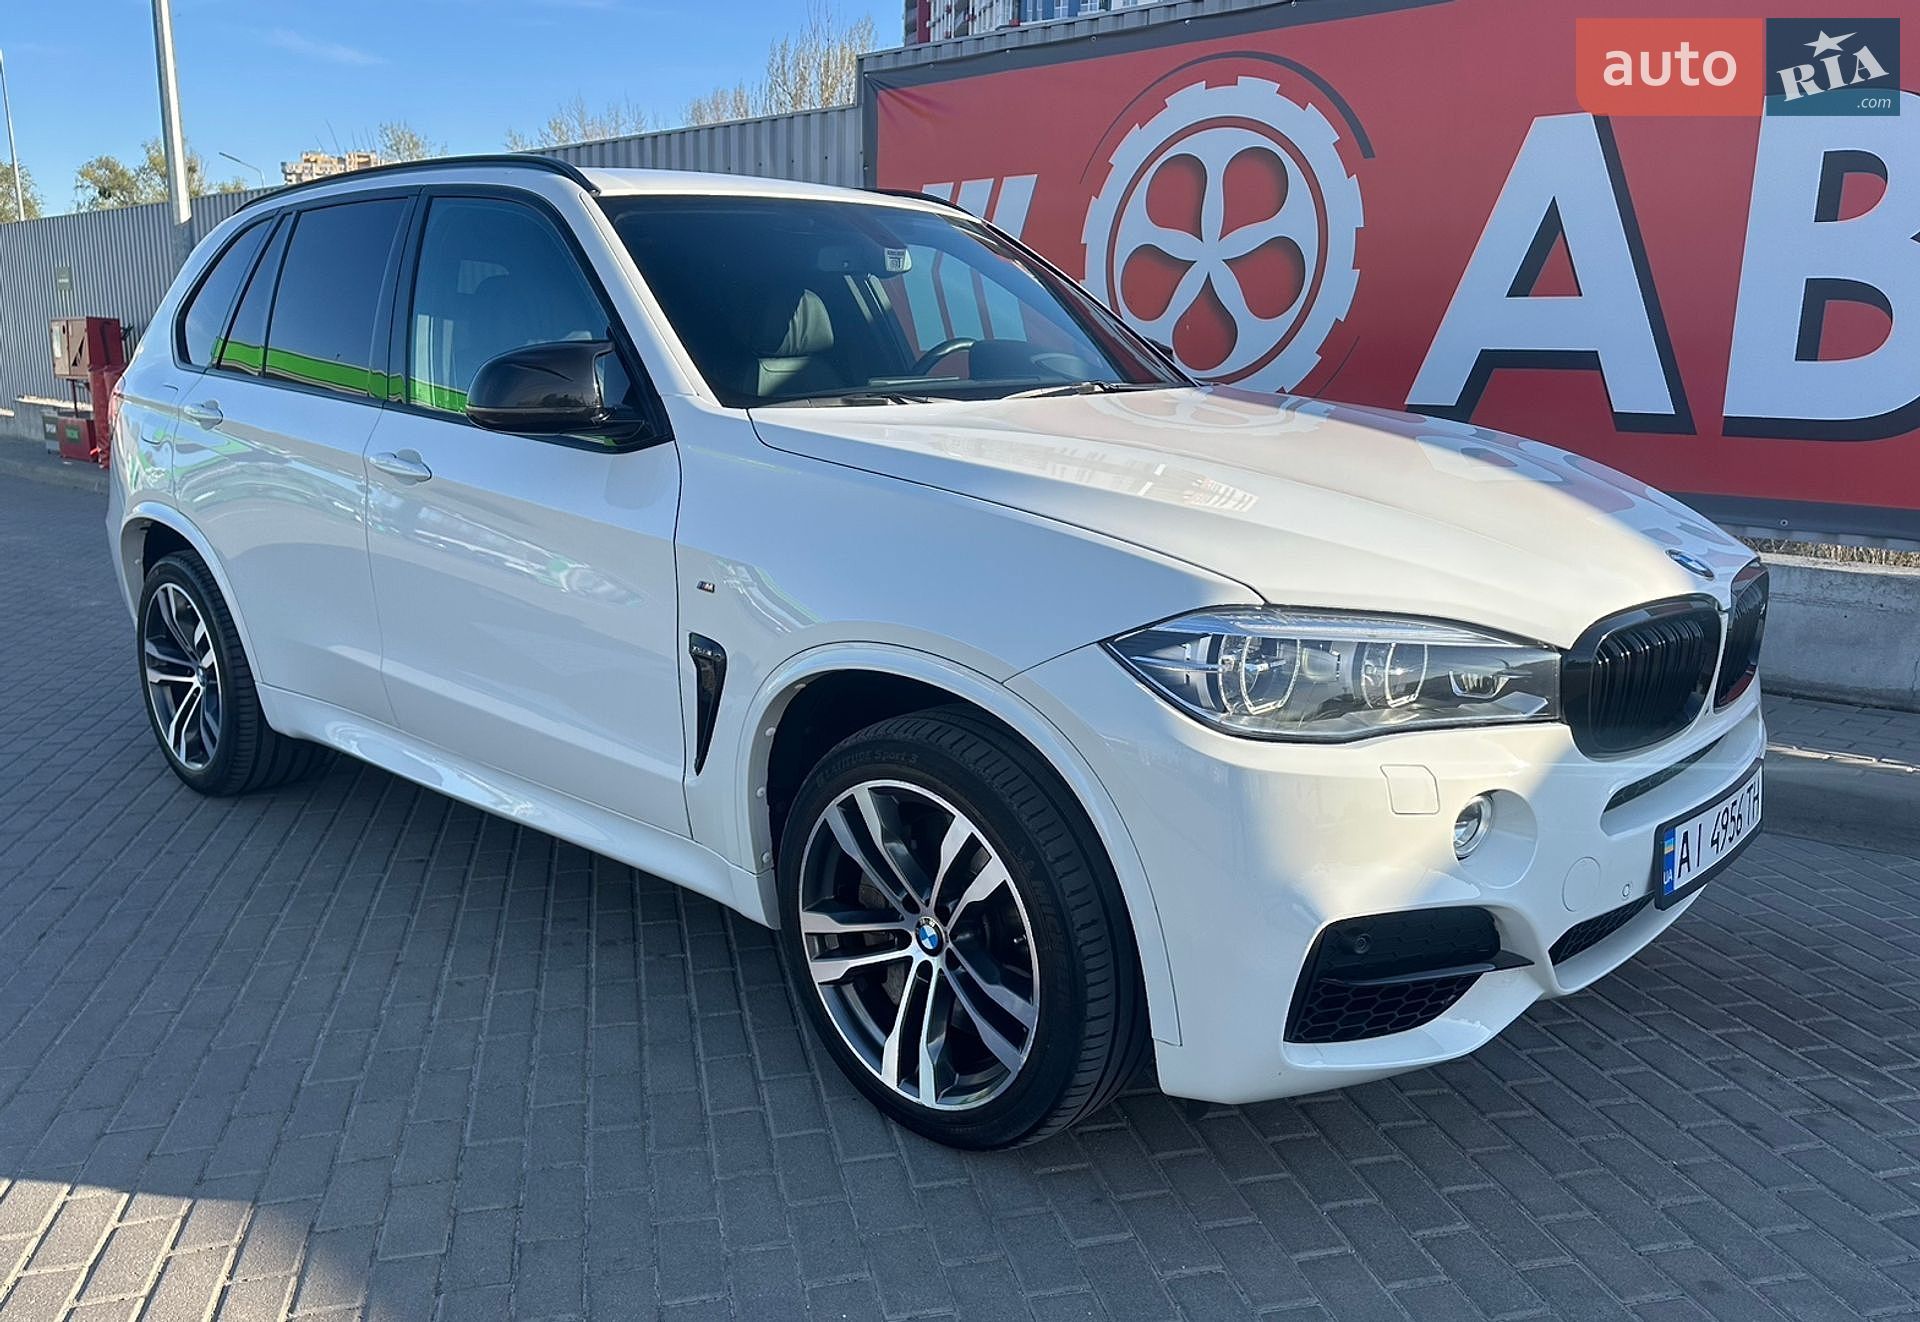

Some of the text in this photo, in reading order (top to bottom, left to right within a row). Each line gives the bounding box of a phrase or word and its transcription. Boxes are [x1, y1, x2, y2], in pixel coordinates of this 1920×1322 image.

[1677, 776, 1760, 879] AI 4956 TH
